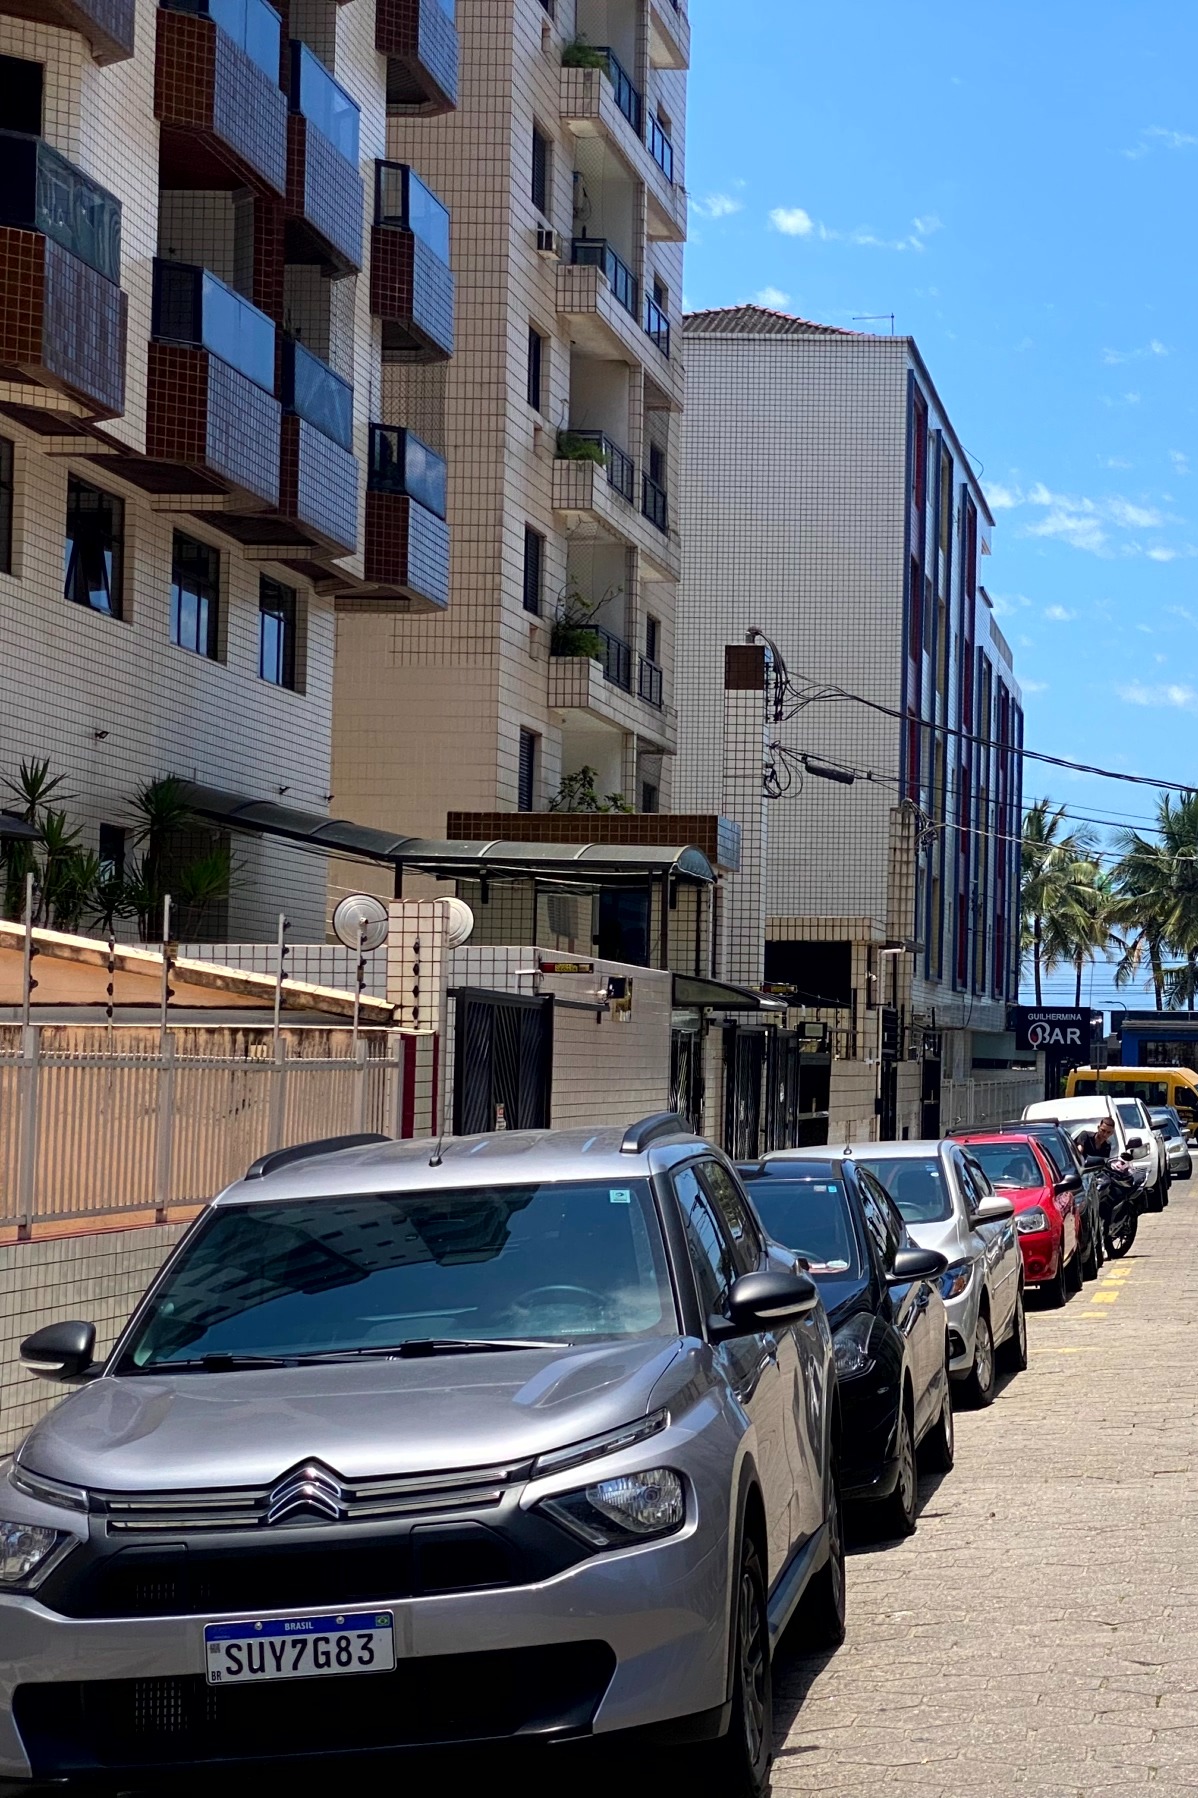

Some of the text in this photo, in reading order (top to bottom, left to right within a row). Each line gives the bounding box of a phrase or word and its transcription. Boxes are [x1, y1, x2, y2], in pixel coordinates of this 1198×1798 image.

[1027, 1022, 1082, 1050] BAR
[284, 1621, 314, 1631] BRASIL
[225, 1633, 374, 1676] SUY7G83
[211, 1670, 222, 1682] BR
